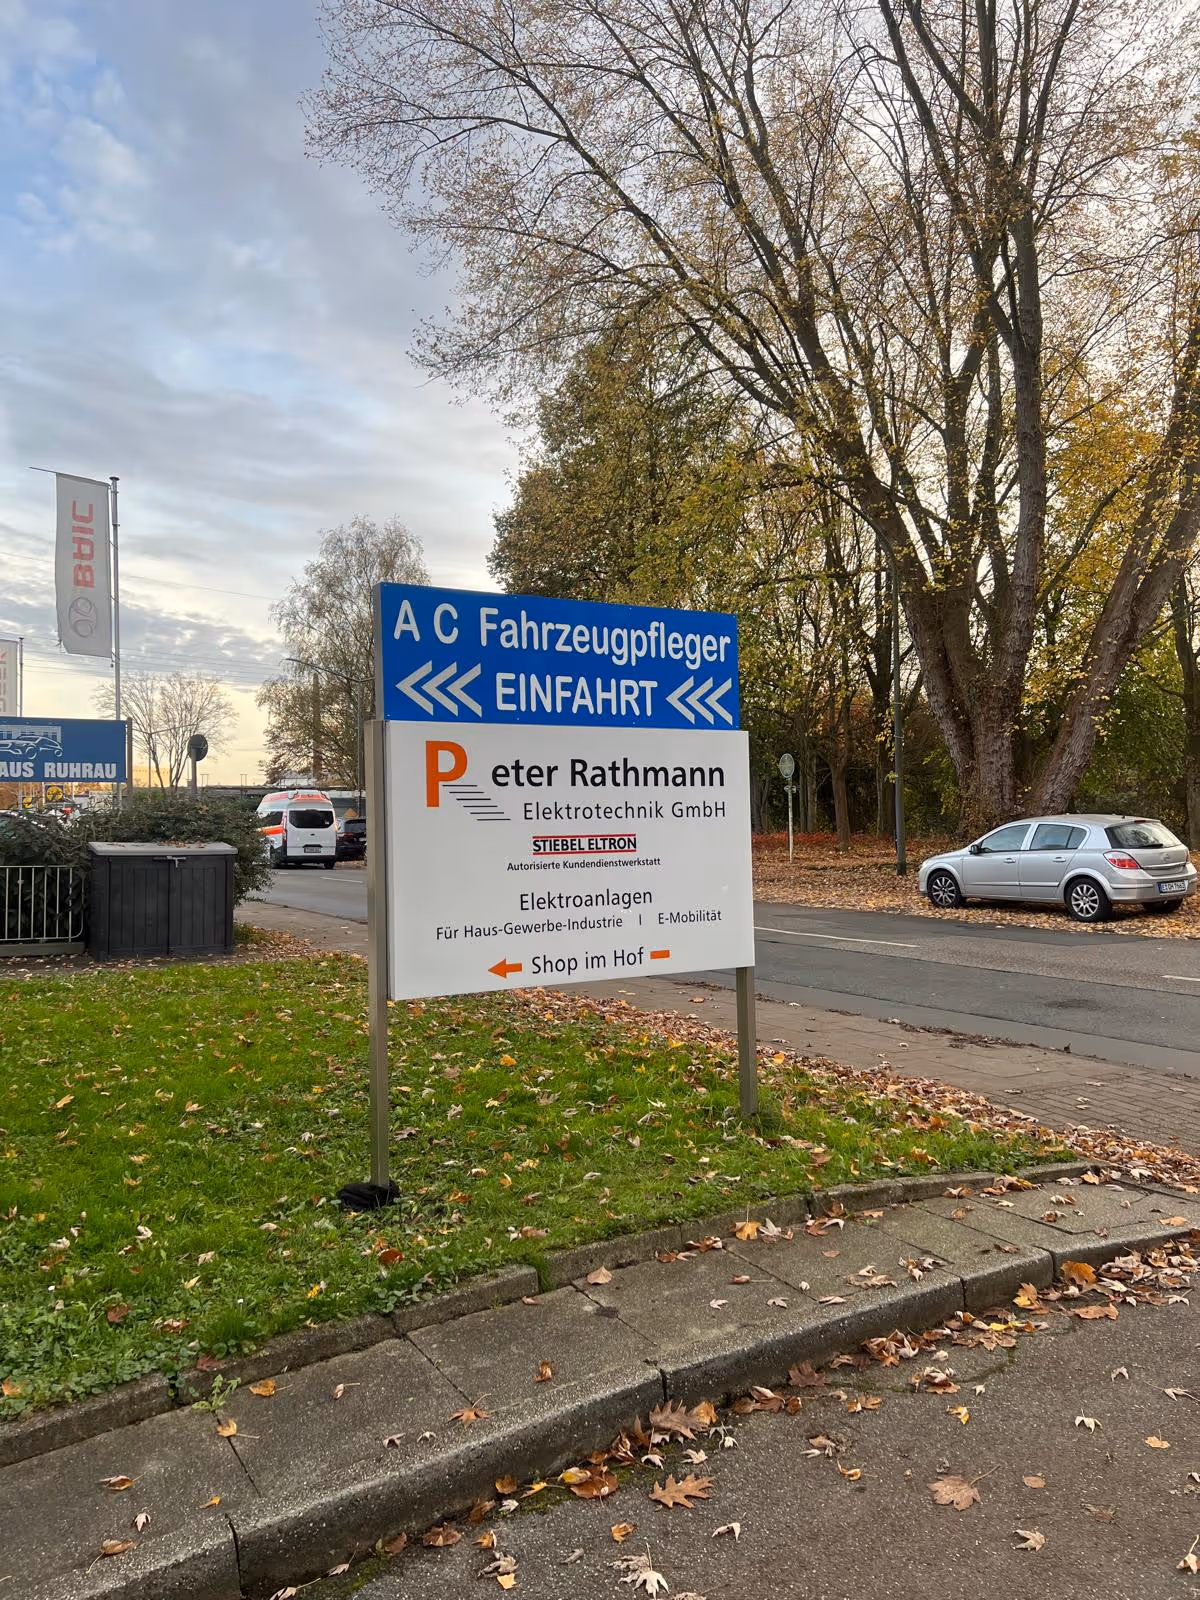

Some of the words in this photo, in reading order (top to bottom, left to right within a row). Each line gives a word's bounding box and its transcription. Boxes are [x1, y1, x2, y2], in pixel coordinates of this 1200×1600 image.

[393, 599, 421, 642] A
[433, 602, 459, 644] C
[479, 607, 731, 670] Fahrzeugpfleger
[496, 672, 658, 717] EINFAHRT
[44, 762, 117, 779] RUHRAU
[570, 757, 725, 787] Rathmann
[523, 800, 665, 820] Elektrotechnik
[671, 800, 726, 818] GmbH
[532, 838, 585, 853] STIEBEL
[587, 836, 637, 851] ELTRON
[506, 861, 561, 871] Autorisierte
[562, 857, 661, 870] Kundendienstwerkstatt
[520, 888, 653, 911] Elektroanlagen
[436, 926, 459, 940] Für
[464, 915, 623, 938] Haus-Gewerbe-Industrie
[658, 909, 722, 925] E-Mobilität
[531, 954, 578, 976] Shop
[585, 951, 606, 969] im
[614, 946, 644, 967] Hof
